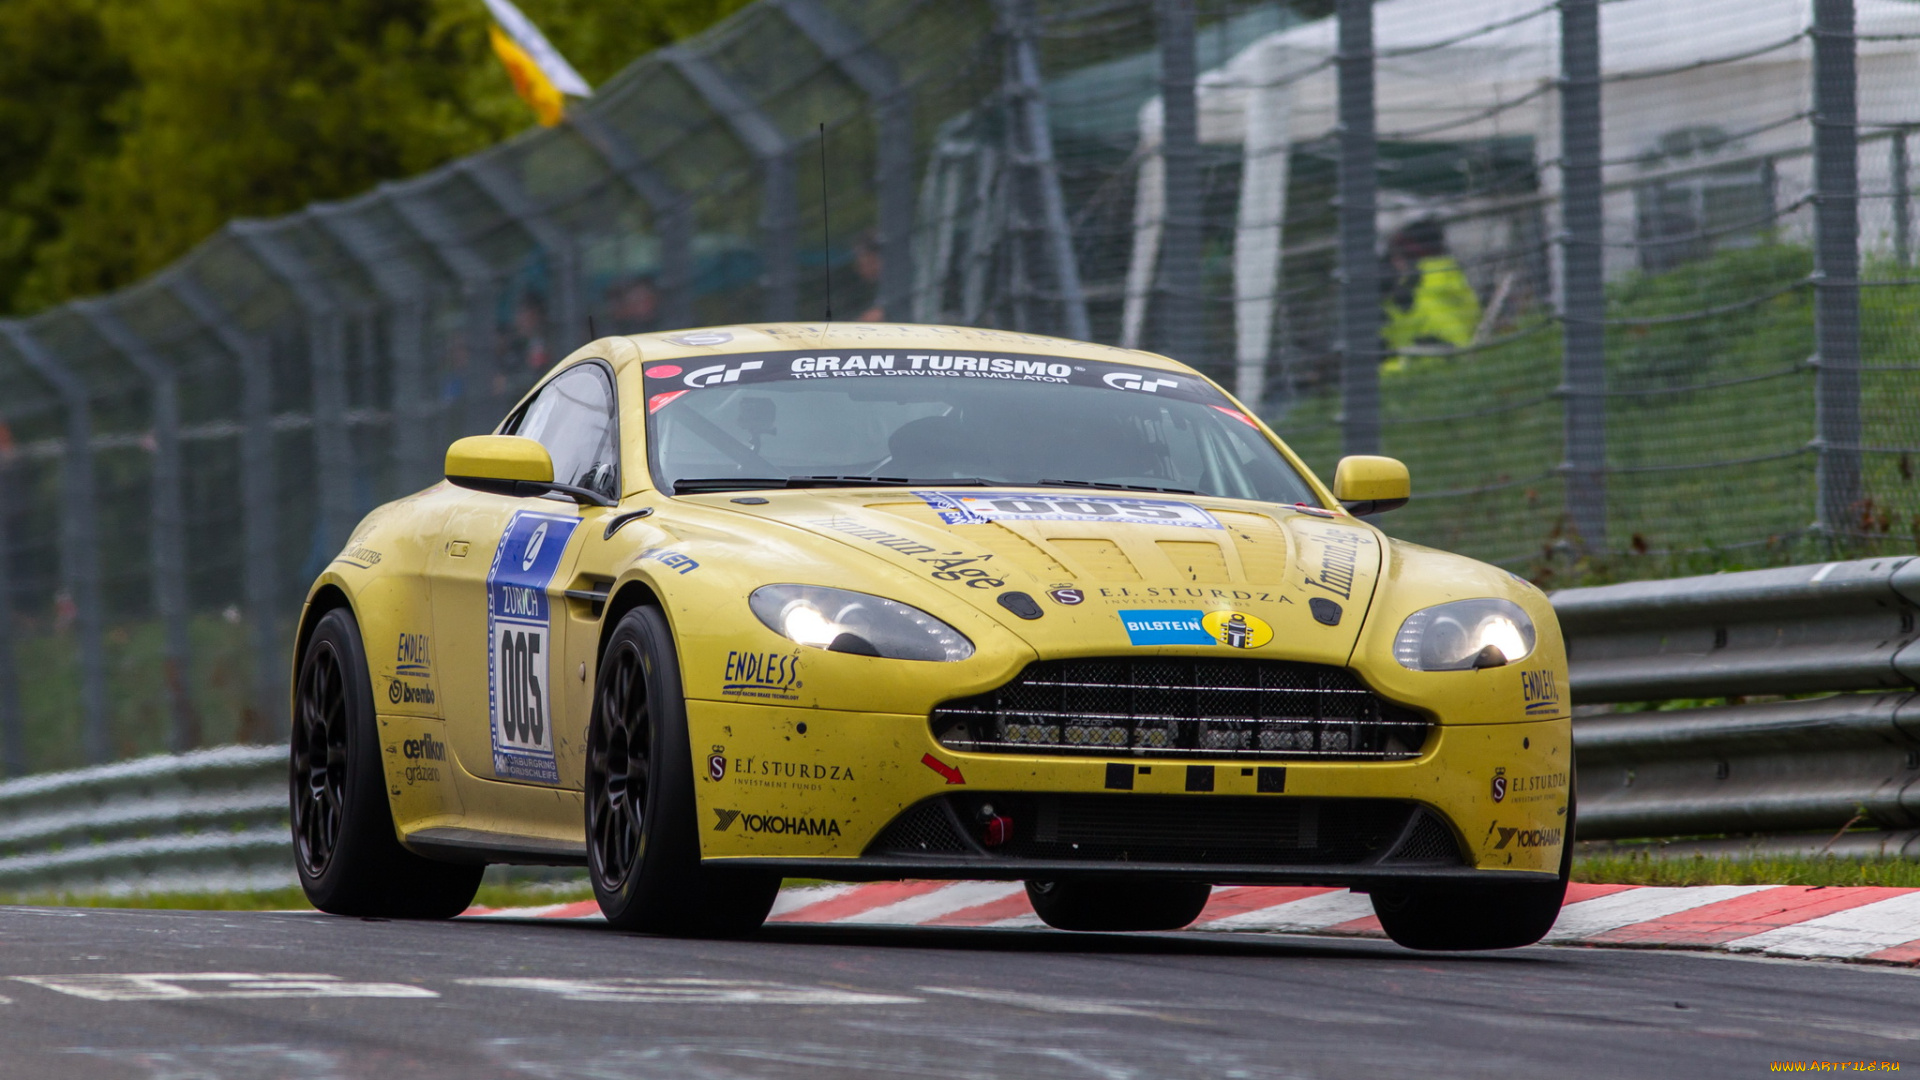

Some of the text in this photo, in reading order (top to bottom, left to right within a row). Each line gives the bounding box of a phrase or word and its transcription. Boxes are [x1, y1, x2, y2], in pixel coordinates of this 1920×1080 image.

[683, 361, 764, 388] GT
[790, 355, 1072, 377] GRAN TURISMO
[791, 370, 1069, 384] THE REAL DRIVING SIMULATOR
[1102, 372, 1178, 392] GT
[990, 500, 1182, 519] 005
[502, 586, 539, 617] ZURICH
[1099, 588, 1295, 604] E.I. STURDZA
[1127, 621, 1201, 631] BILSTEIN
[397, 633, 430, 663] ENDLESS
[725, 651, 799, 685] ENDLESS
[404, 682, 435, 704] brembo
[501, 629, 544, 745] 005
[1521, 670, 1556, 701] ENDLESS
[405, 764, 440, 785] graziano
[735, 758, 854, 781] E.I. STURDZA
[734, 778, 822, 791] INVESTMENT FUNDS
[1529, 773, 1567, 791] STURDZA
[741, 813, 841, 836] YOKOHAMA
[1517, 828, 1561, 847] YOKOHAMA
